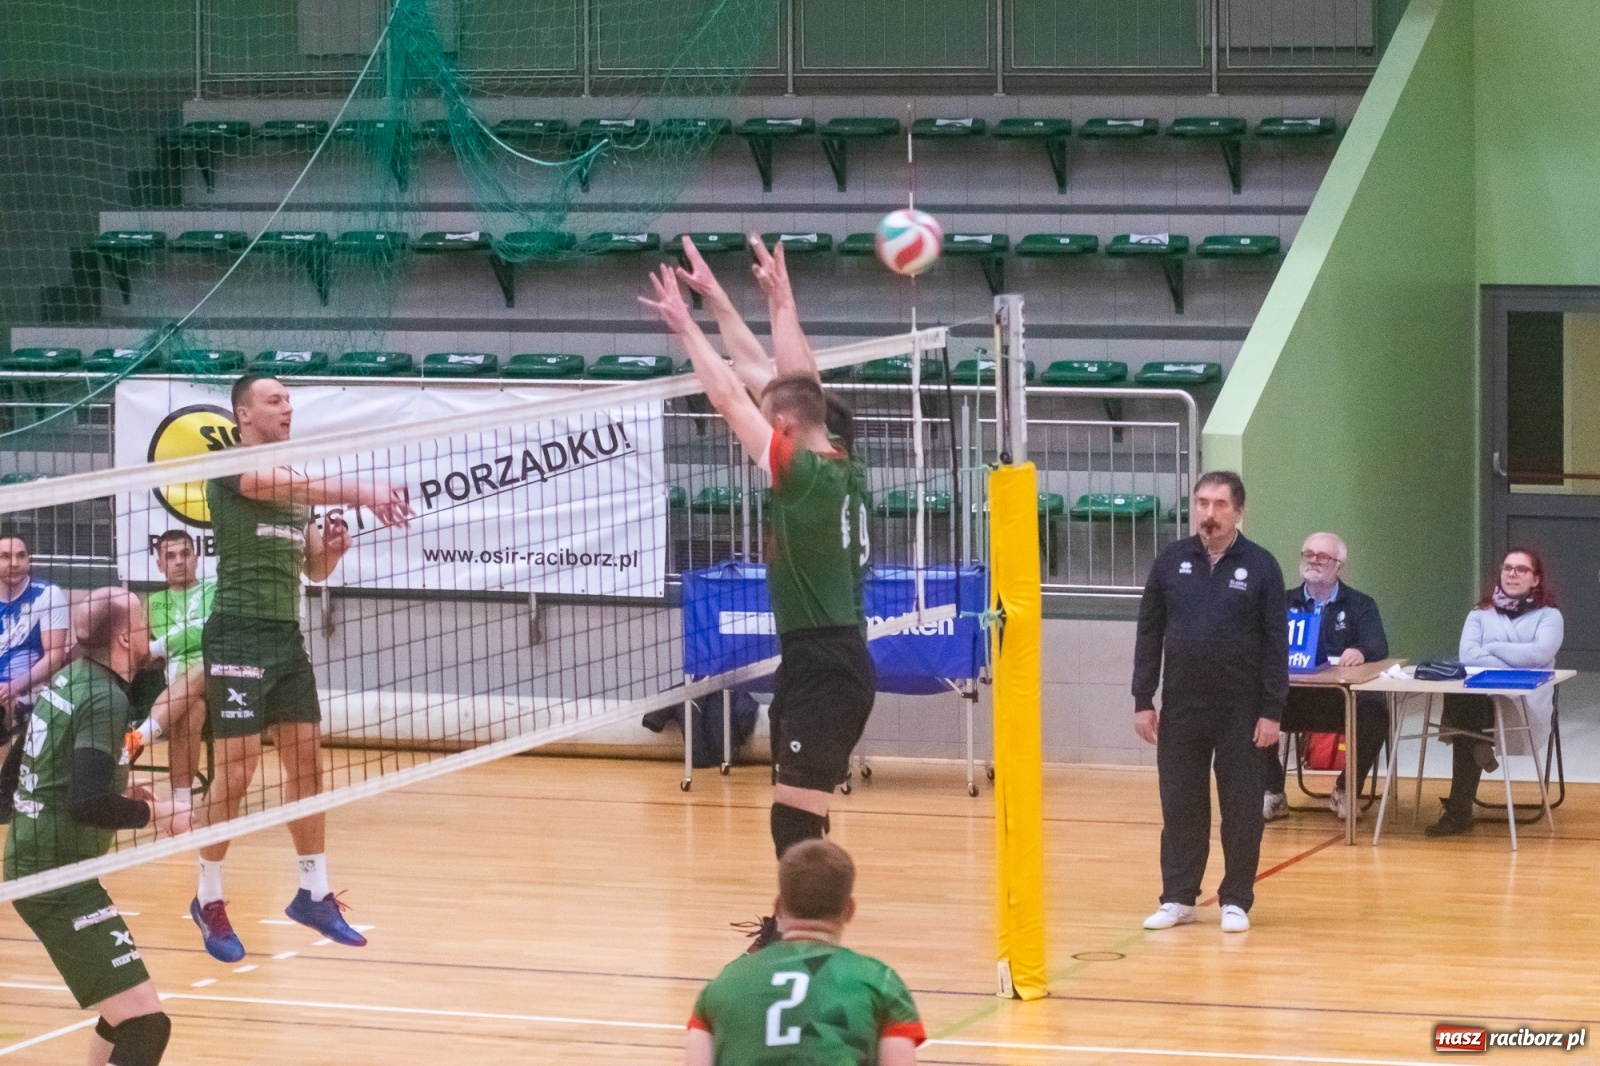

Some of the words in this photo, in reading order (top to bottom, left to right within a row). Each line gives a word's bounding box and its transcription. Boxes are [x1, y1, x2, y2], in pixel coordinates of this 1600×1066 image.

[419, 421, 632, 509] PORZĄDKU!
[423, 547, 638, 572] www.osir-raciborz.pl
[1288, 619, 1306, 646] 11
[765, 971, 810, 1047] 2
